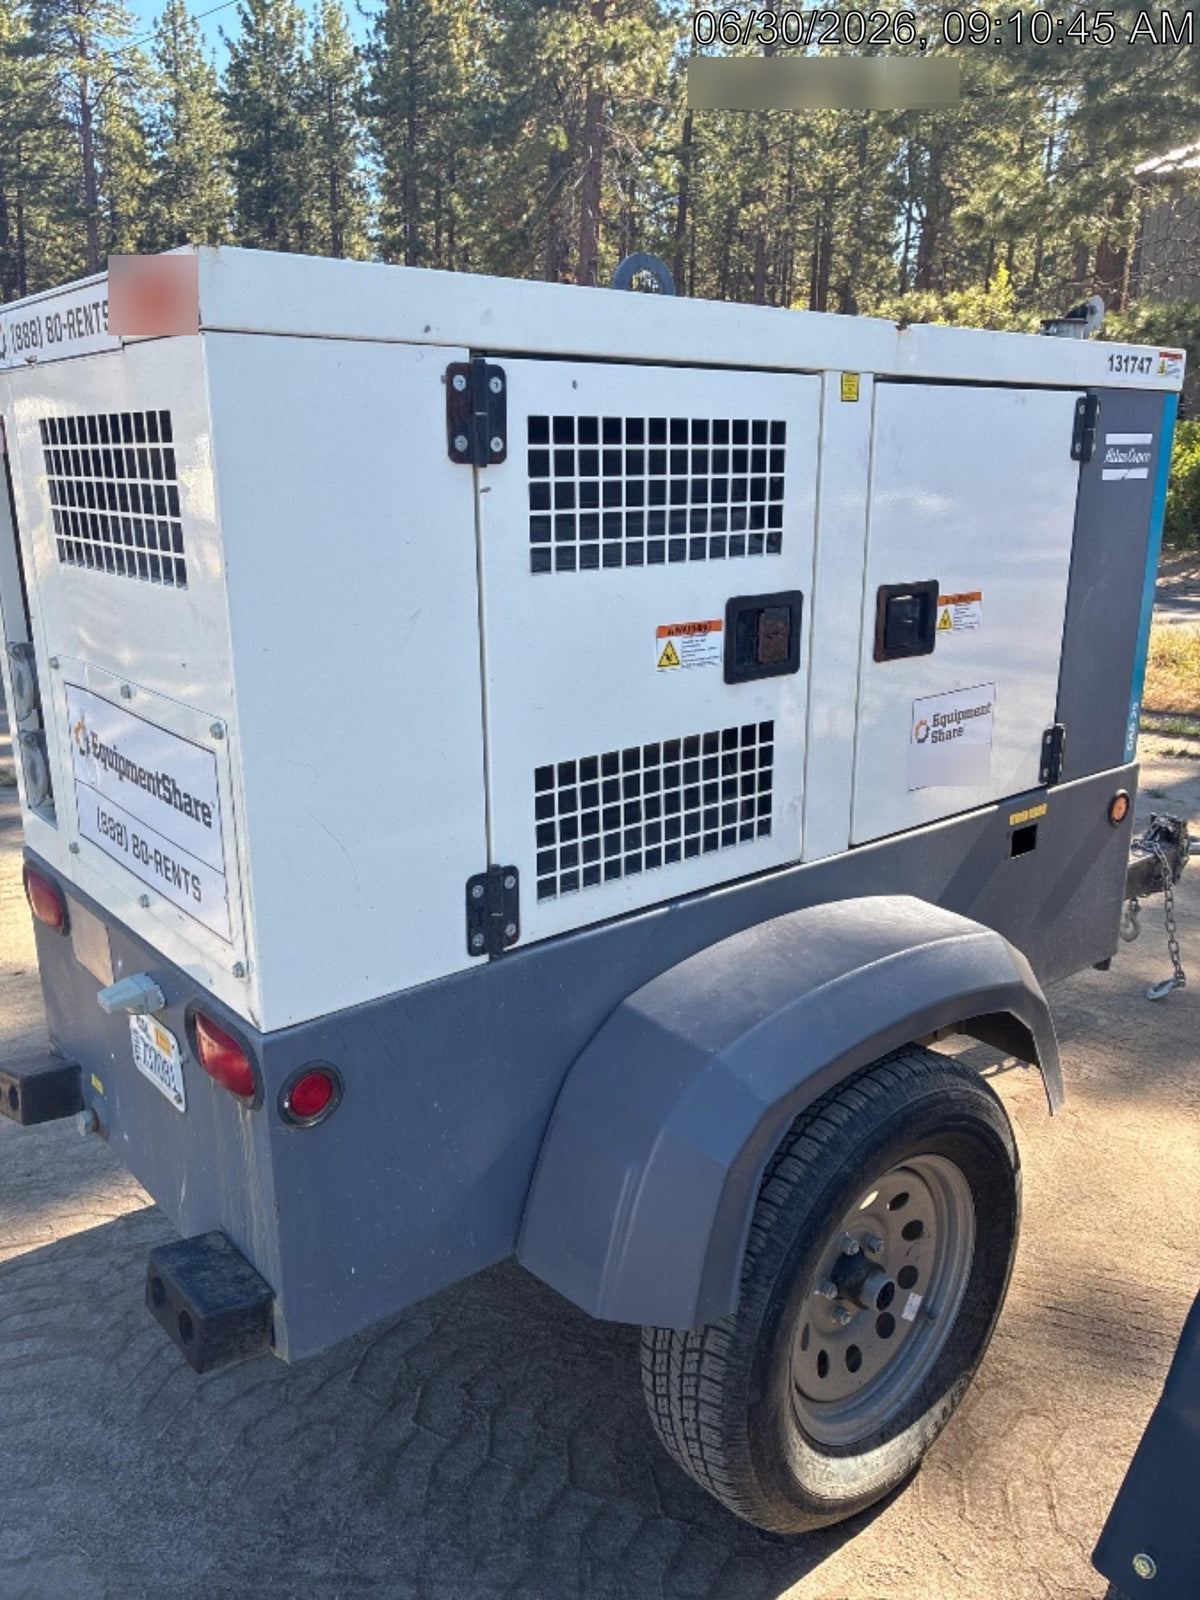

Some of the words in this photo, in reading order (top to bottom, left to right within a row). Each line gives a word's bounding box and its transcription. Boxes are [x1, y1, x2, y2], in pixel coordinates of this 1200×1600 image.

[10, 316, 43, 354] (888)
[1108, 354, 1153, 375] 131747
[932, 702, 992, 728] Equipment
[931, 727, 964, 744] Share
[89, 729, 213, 829] EquipmentShare
[96, 805, 129, 852] (888)
[132, 833, 202, 903] 80-RENTS
